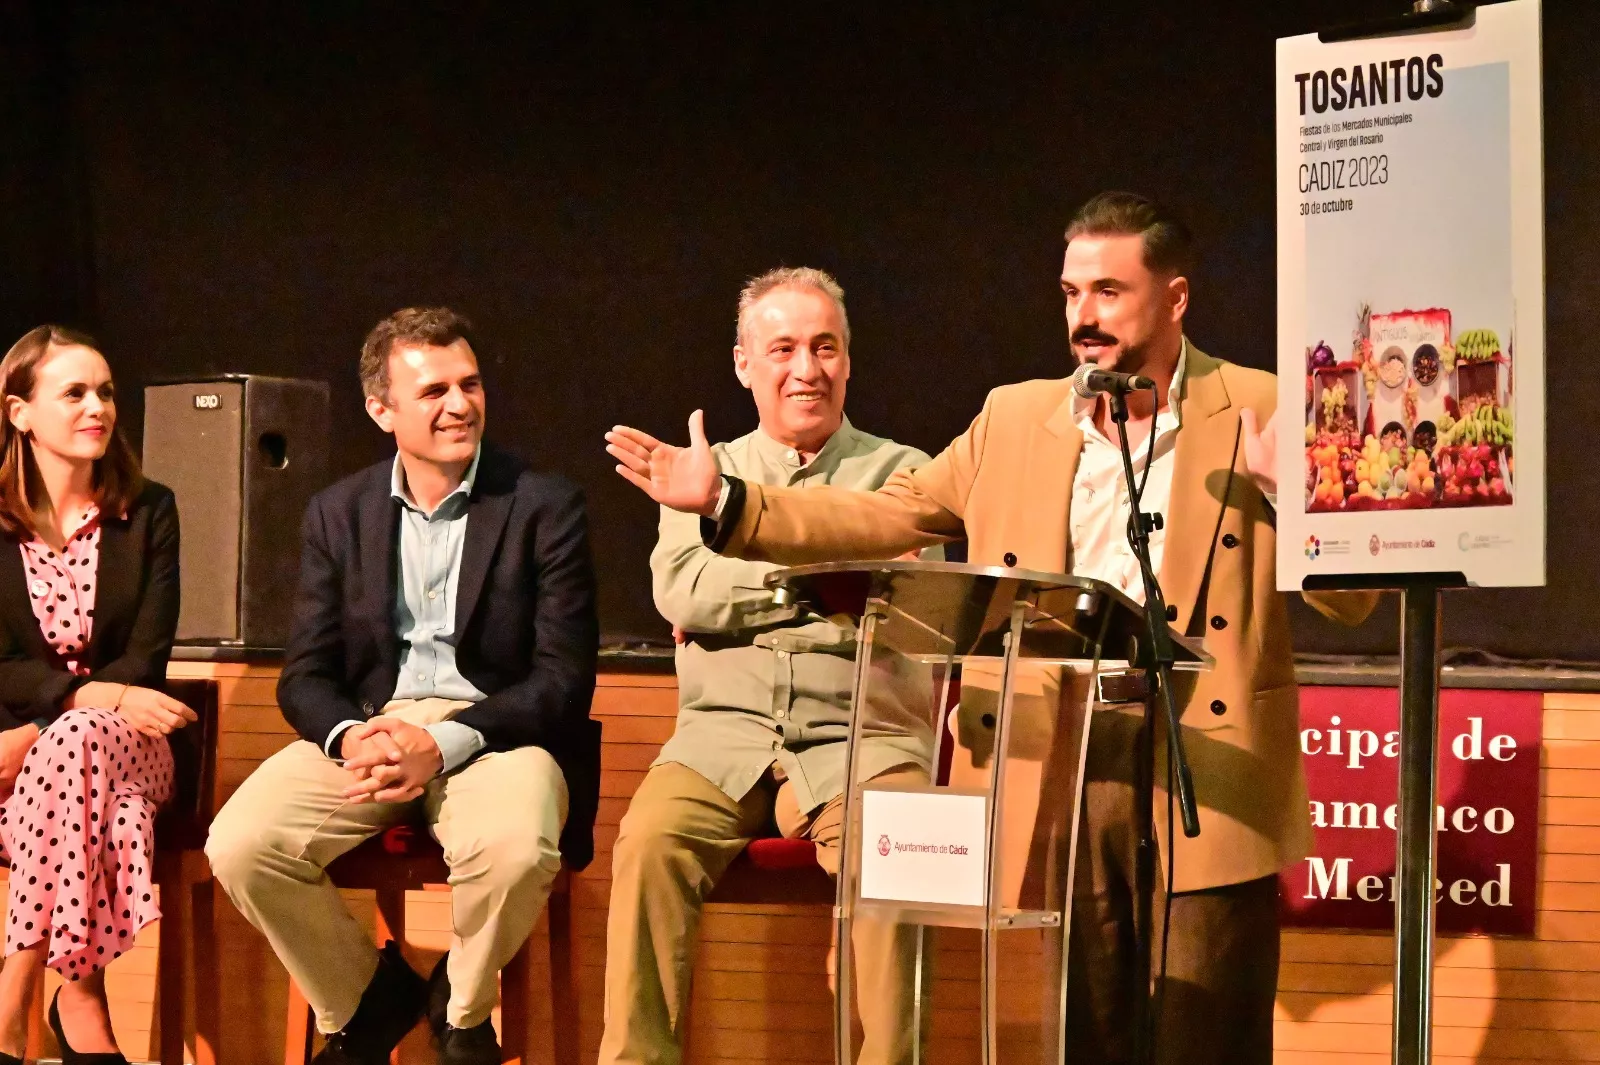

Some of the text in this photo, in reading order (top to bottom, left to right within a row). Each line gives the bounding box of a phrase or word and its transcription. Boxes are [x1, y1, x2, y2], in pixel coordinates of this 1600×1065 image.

[1295, 53, 1444, 116] TOSANTOS
[1299, 112, 1413, 137] Fiestas de los Mercados Municipales
[1299, 141, 1322, 153] Central
[1327, 137, 1348, 151] Virgen
[1348, 135, 1359, 147] del
[1359, 132, 1384, 145] Rosario
[1298, 154, 1389, 193] CADIZ 2023
[1299, 198, 1353, 216] 30 de octubre
[196, 394, 218, 408] NEXO
[1300, 715, 1517, 769] cipa de
[894, 841, 969, 856] Ayuntamiento de Cádiz
